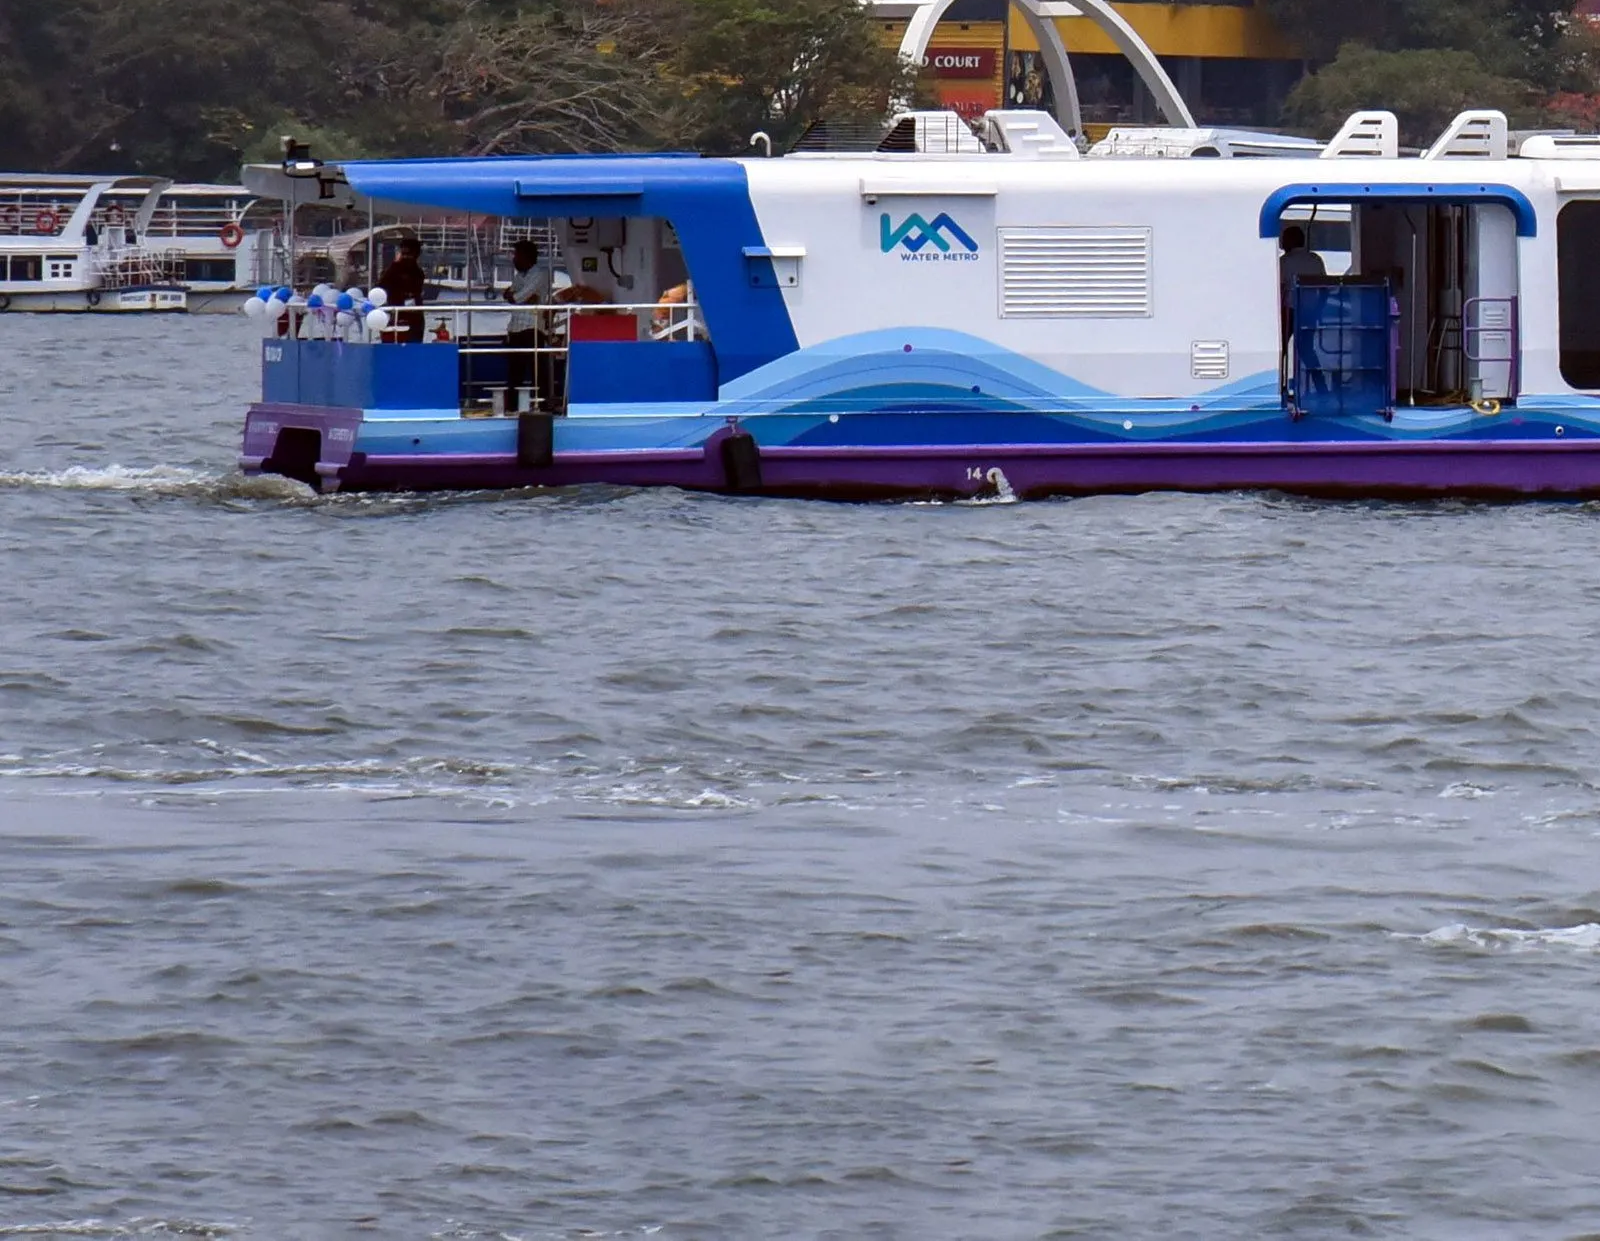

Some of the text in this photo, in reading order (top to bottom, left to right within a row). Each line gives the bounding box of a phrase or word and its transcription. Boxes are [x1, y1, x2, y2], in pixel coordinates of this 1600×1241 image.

[935, 56, 981, 68] COURT
[901, 253, 979, 261] WATER METRO
[966, 466, 983, 480] 14
